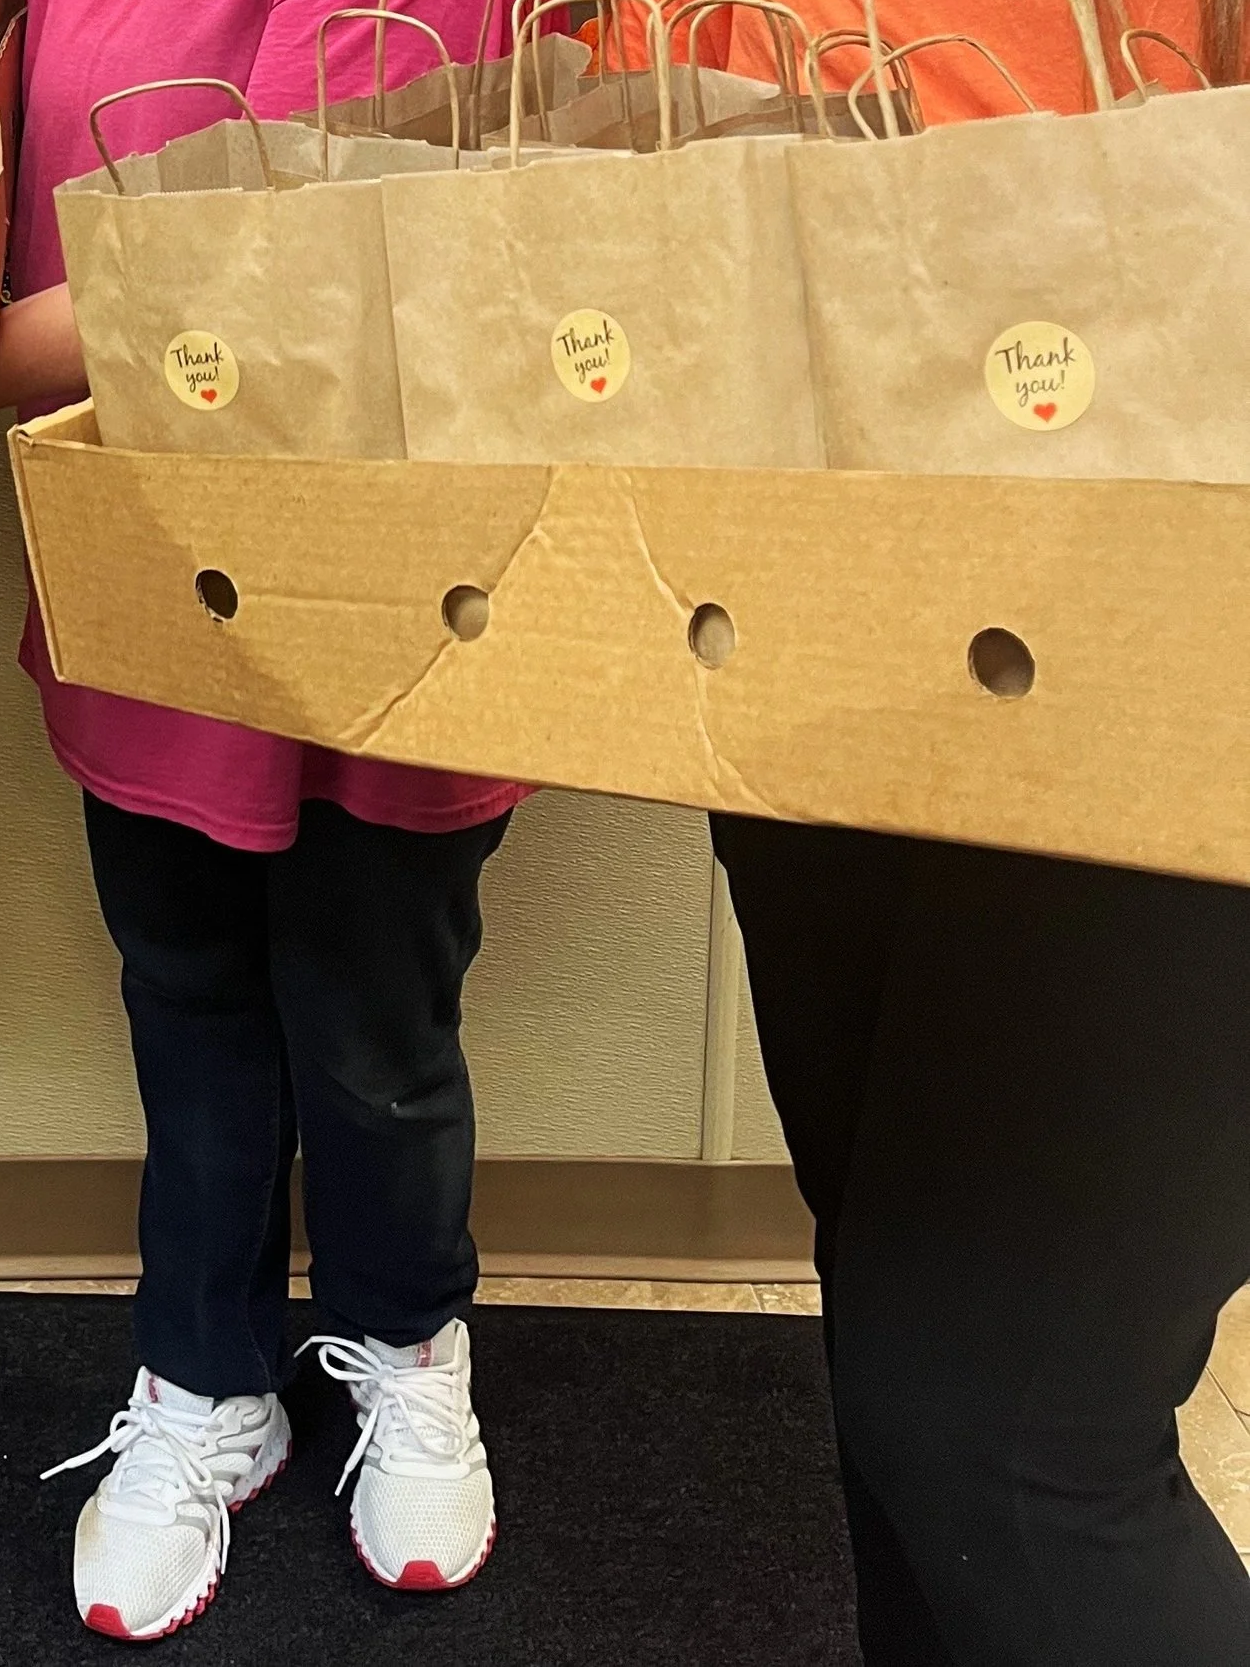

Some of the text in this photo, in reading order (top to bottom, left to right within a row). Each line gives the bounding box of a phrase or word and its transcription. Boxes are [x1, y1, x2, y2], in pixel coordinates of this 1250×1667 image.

[170, 341, 224, 368] Thank
[556, 319, 614, 356] Thank
[994, 337, 1076, 374] Thank
[186, 366, 220, 393] you!
[575, 348, 611, 384] you!
[1015, 370, 1066, 408] you!
